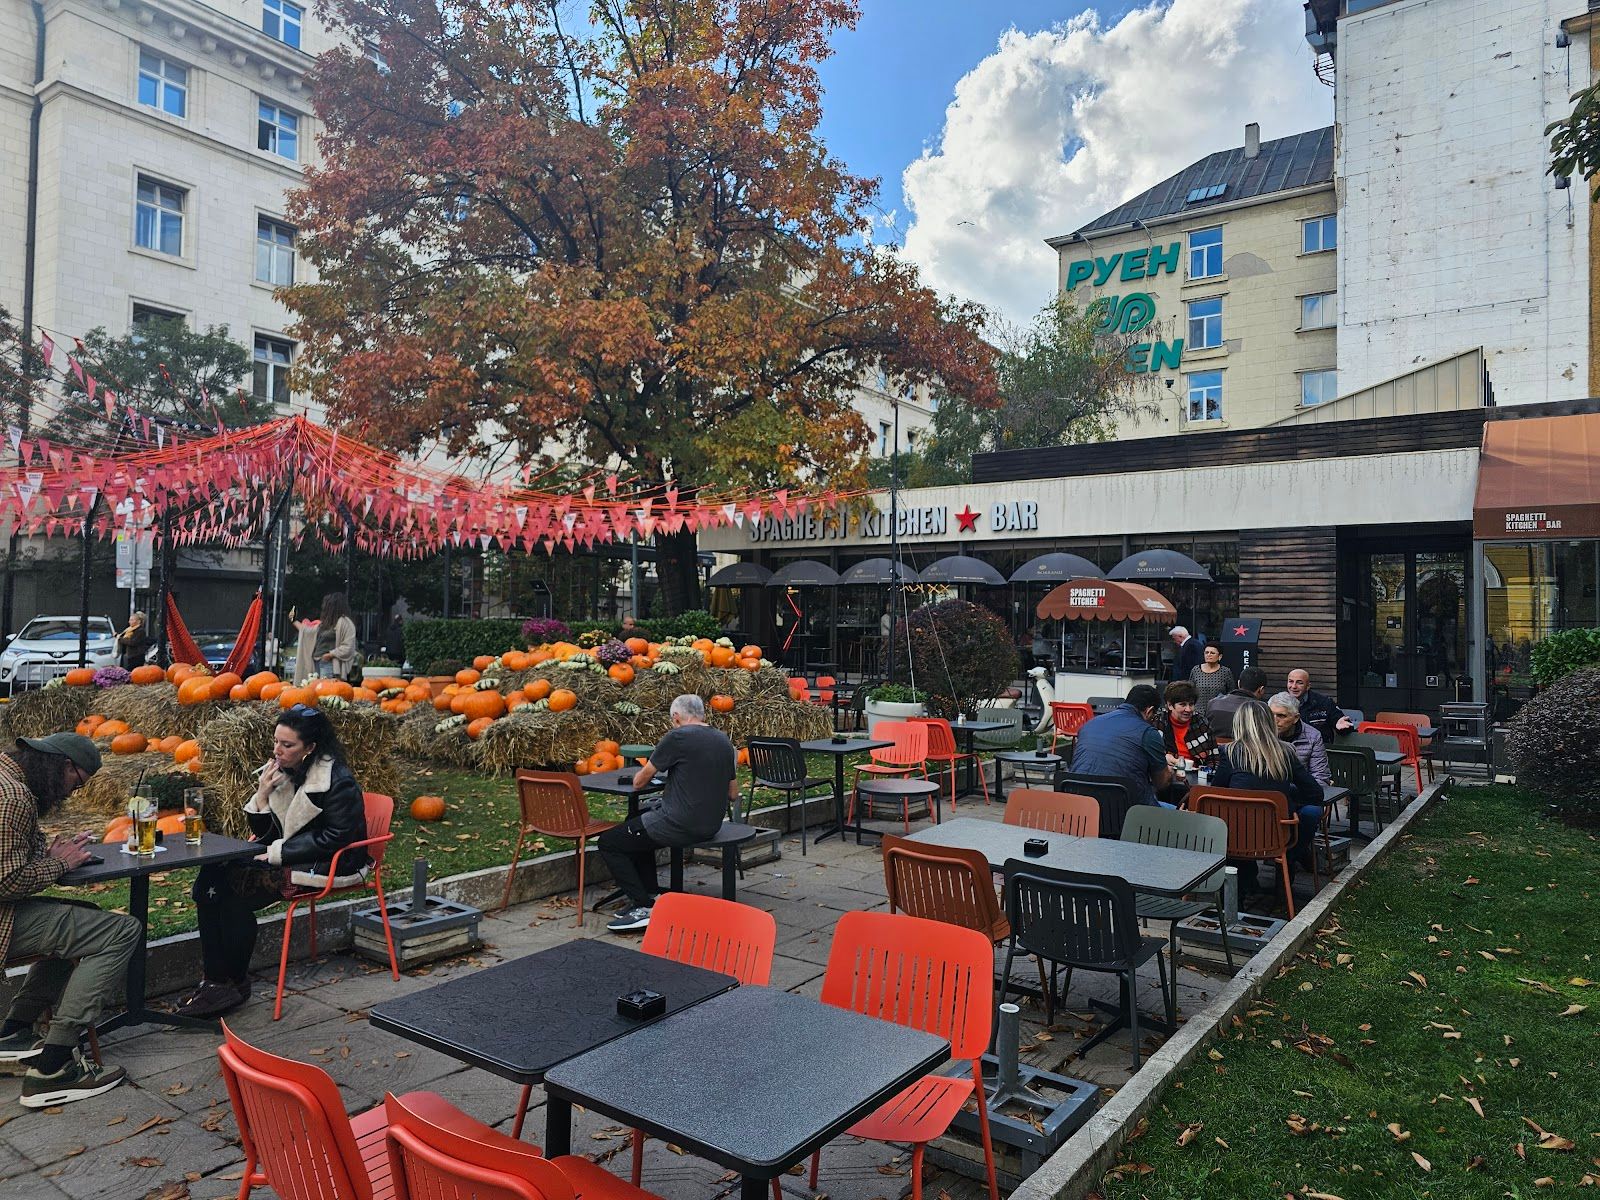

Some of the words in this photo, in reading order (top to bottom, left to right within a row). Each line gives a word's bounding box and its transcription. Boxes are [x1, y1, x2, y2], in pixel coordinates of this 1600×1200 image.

[1065, 242, 1181, 291] РУЕН
[860, 506, 947, 537] KITCHEN
[991, 502, 1038, 532] BAR
[1505, 513, 1547, 521] SPAGHETTI
[1505, 521, 1538, 530] KITCHEN
[1546, 520, 1562, 529] BAR
[1070, 588, 1106, 597] SPAGHETTI
[1069, 597, 1098, 606] KITCHEN
